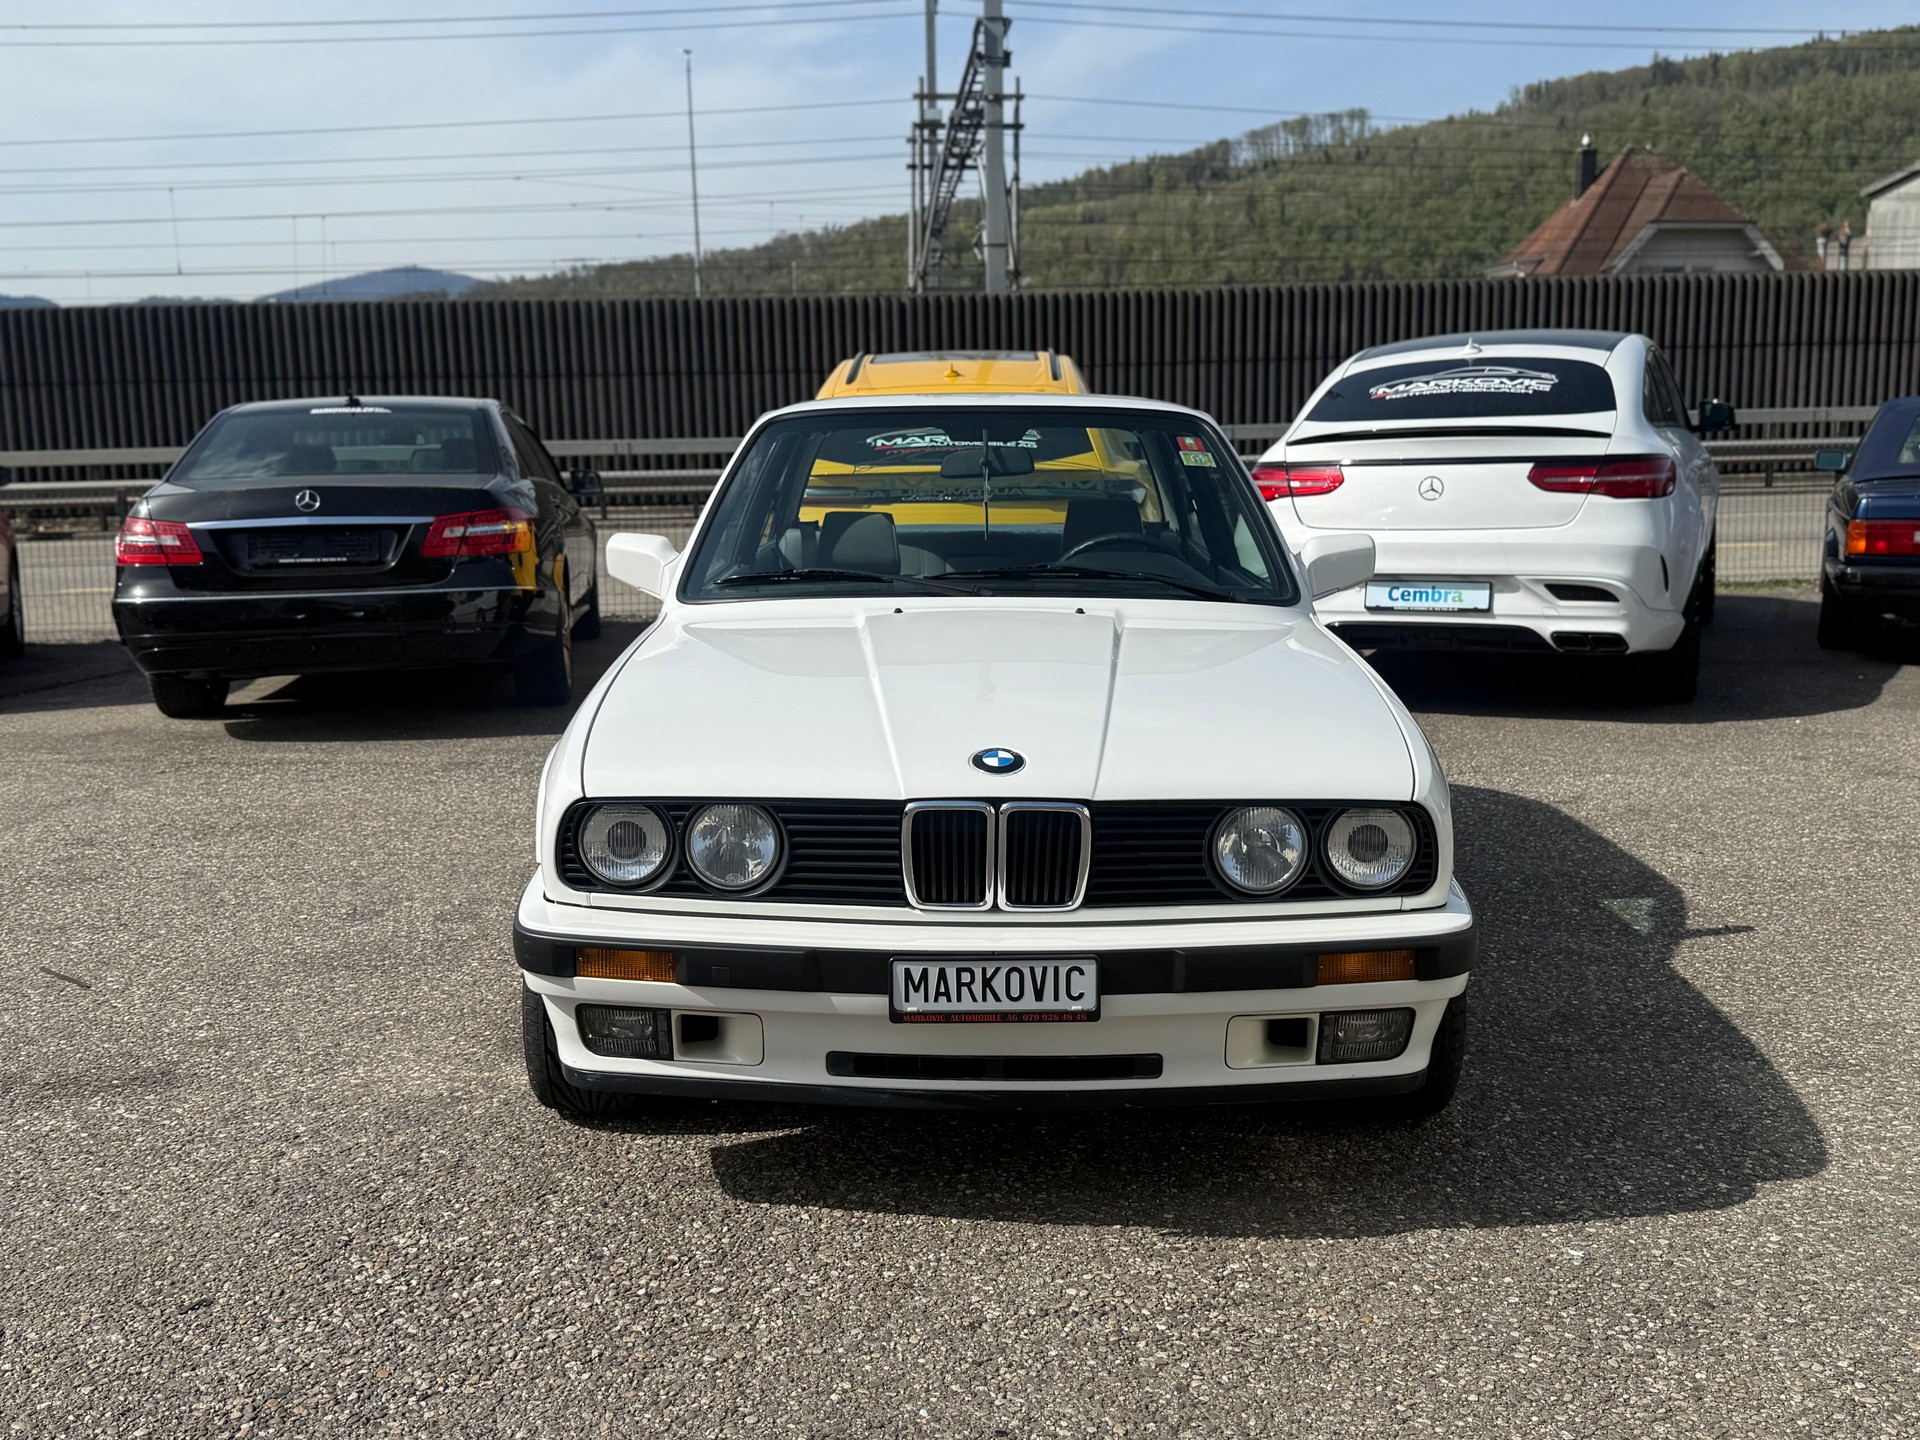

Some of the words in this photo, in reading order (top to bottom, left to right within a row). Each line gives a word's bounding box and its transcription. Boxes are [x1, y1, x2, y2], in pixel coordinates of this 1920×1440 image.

[1377, 378, 1556, 394] MARKOVIC
[1387, 584, 1464, 603] Cembra
[903, 965, 1086, 1003] MARKOVIC
[903, 1014, 946, 1022] MARKOVIC
[950, 1014, 1003, 1022] AUTOMOBILE
[1006, 1014, 1018, 1022] AG
[1022, 1013, 1040, 1022] 079
[1041, 1013, 1059, 1022] 926
[1061, 1013, 1073, 1022] 48
[1075, 1013, 1087, 1022] 48
